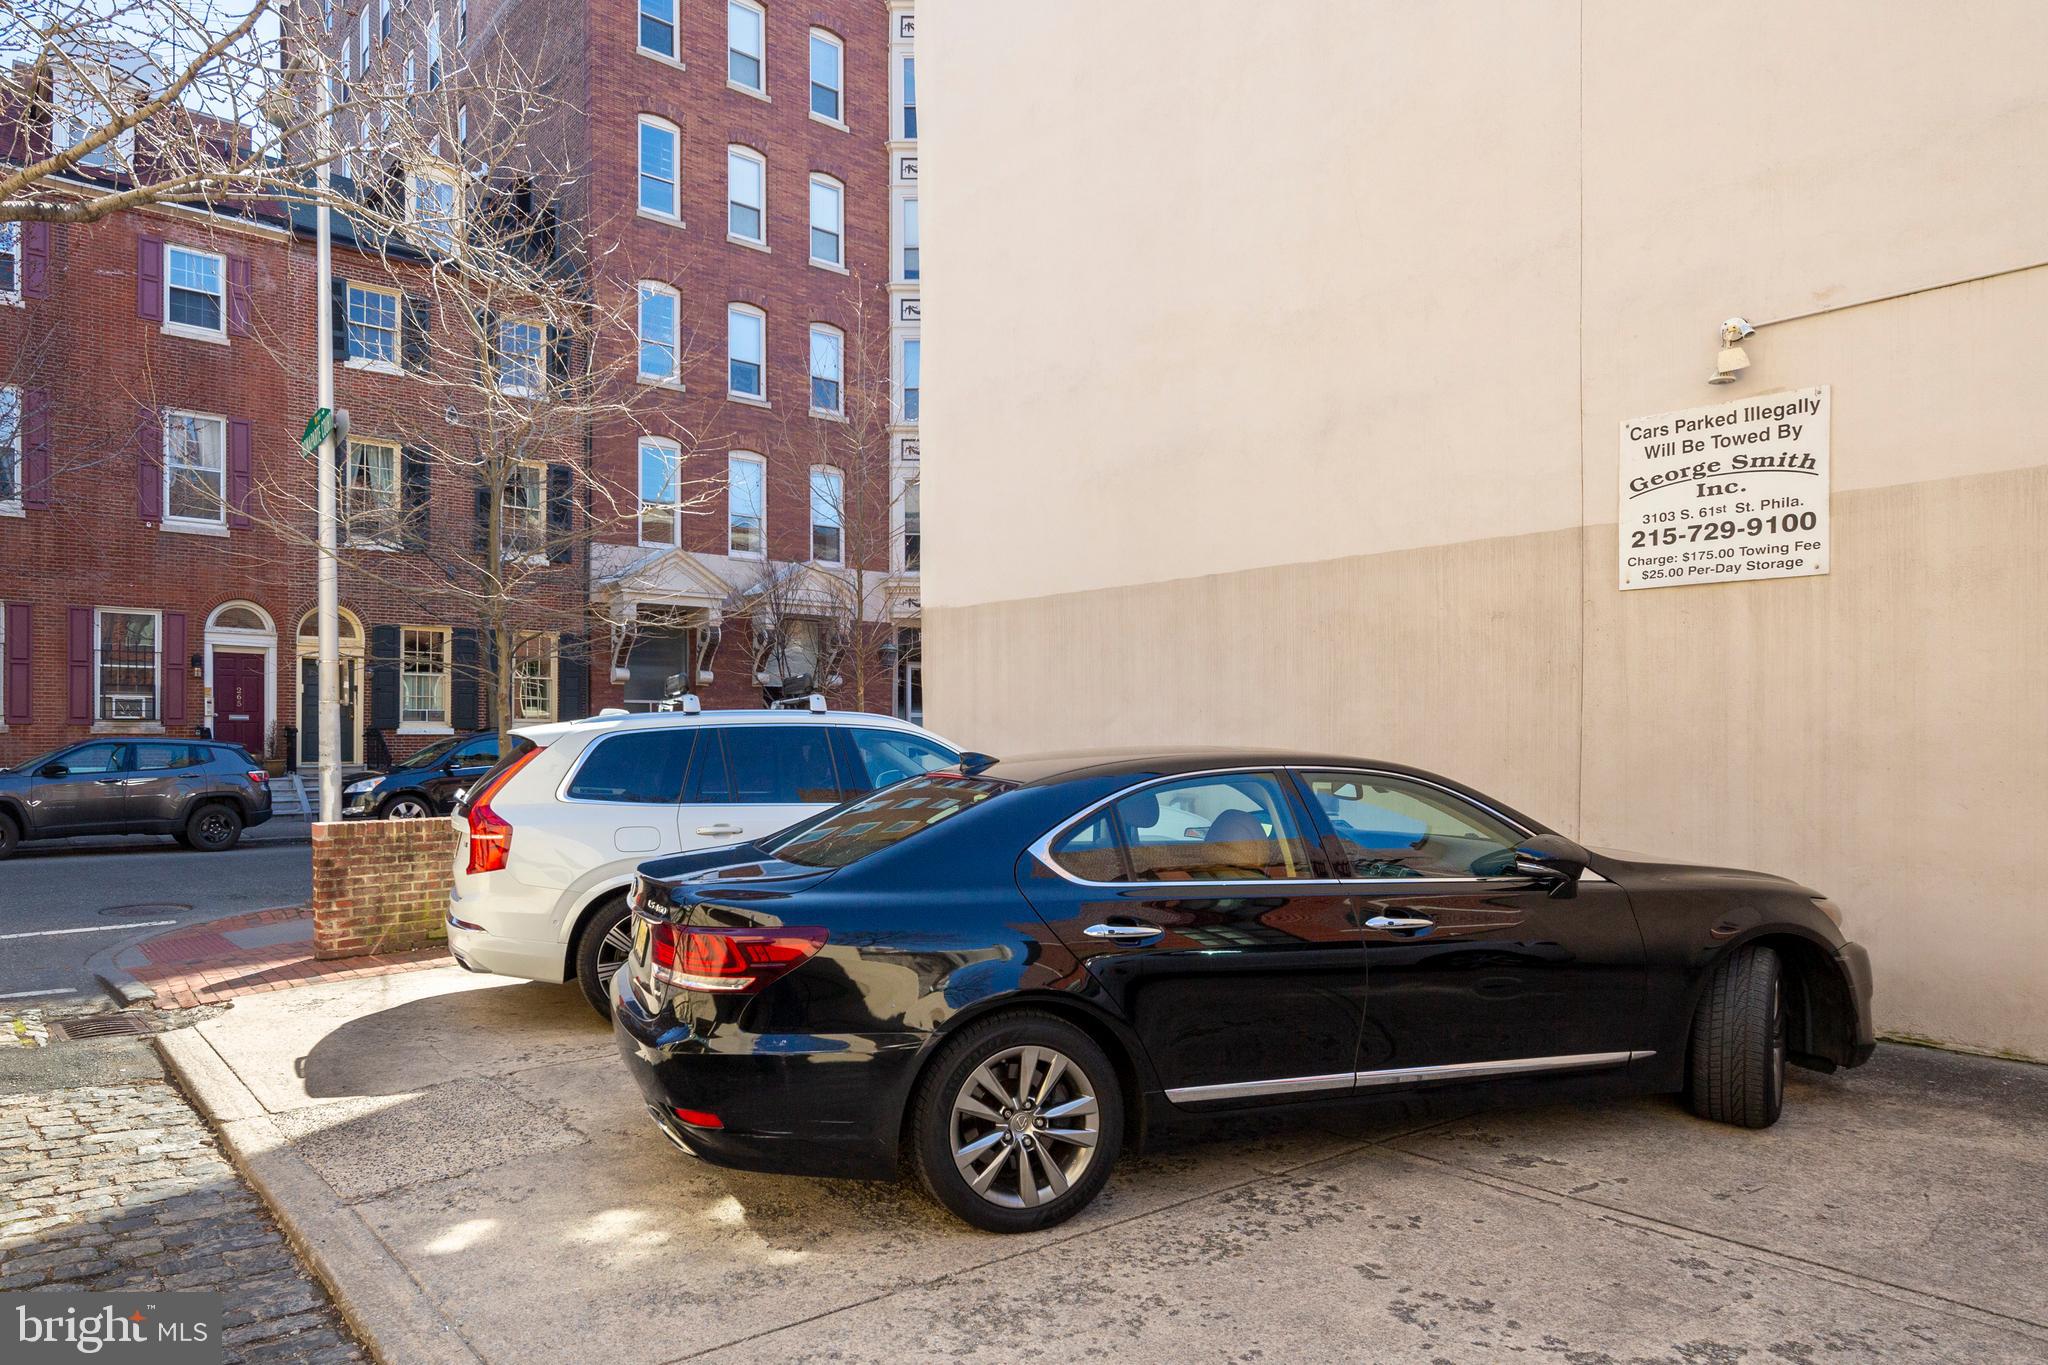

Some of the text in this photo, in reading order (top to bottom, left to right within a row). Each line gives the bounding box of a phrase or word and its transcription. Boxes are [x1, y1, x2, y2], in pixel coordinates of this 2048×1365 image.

[1629, 398, 1821, 441] Cars Parked Illegally
[1644, 423, 1803, 460] Will Be Towed By
[1629, 452, 1817, 493] George Smith
[1696, 482, 1747, 498] Inc.
[1642, 496, 1804, 524] 3103 S. 61st St. Phila.
[1631, 511, 1817, 549] 215-729-9100
[1627, 540, 1822, 568] Charge: $175.00 Towing Fee
[1641, 557, 1804, 581] $25.00 Per-Day Storage
